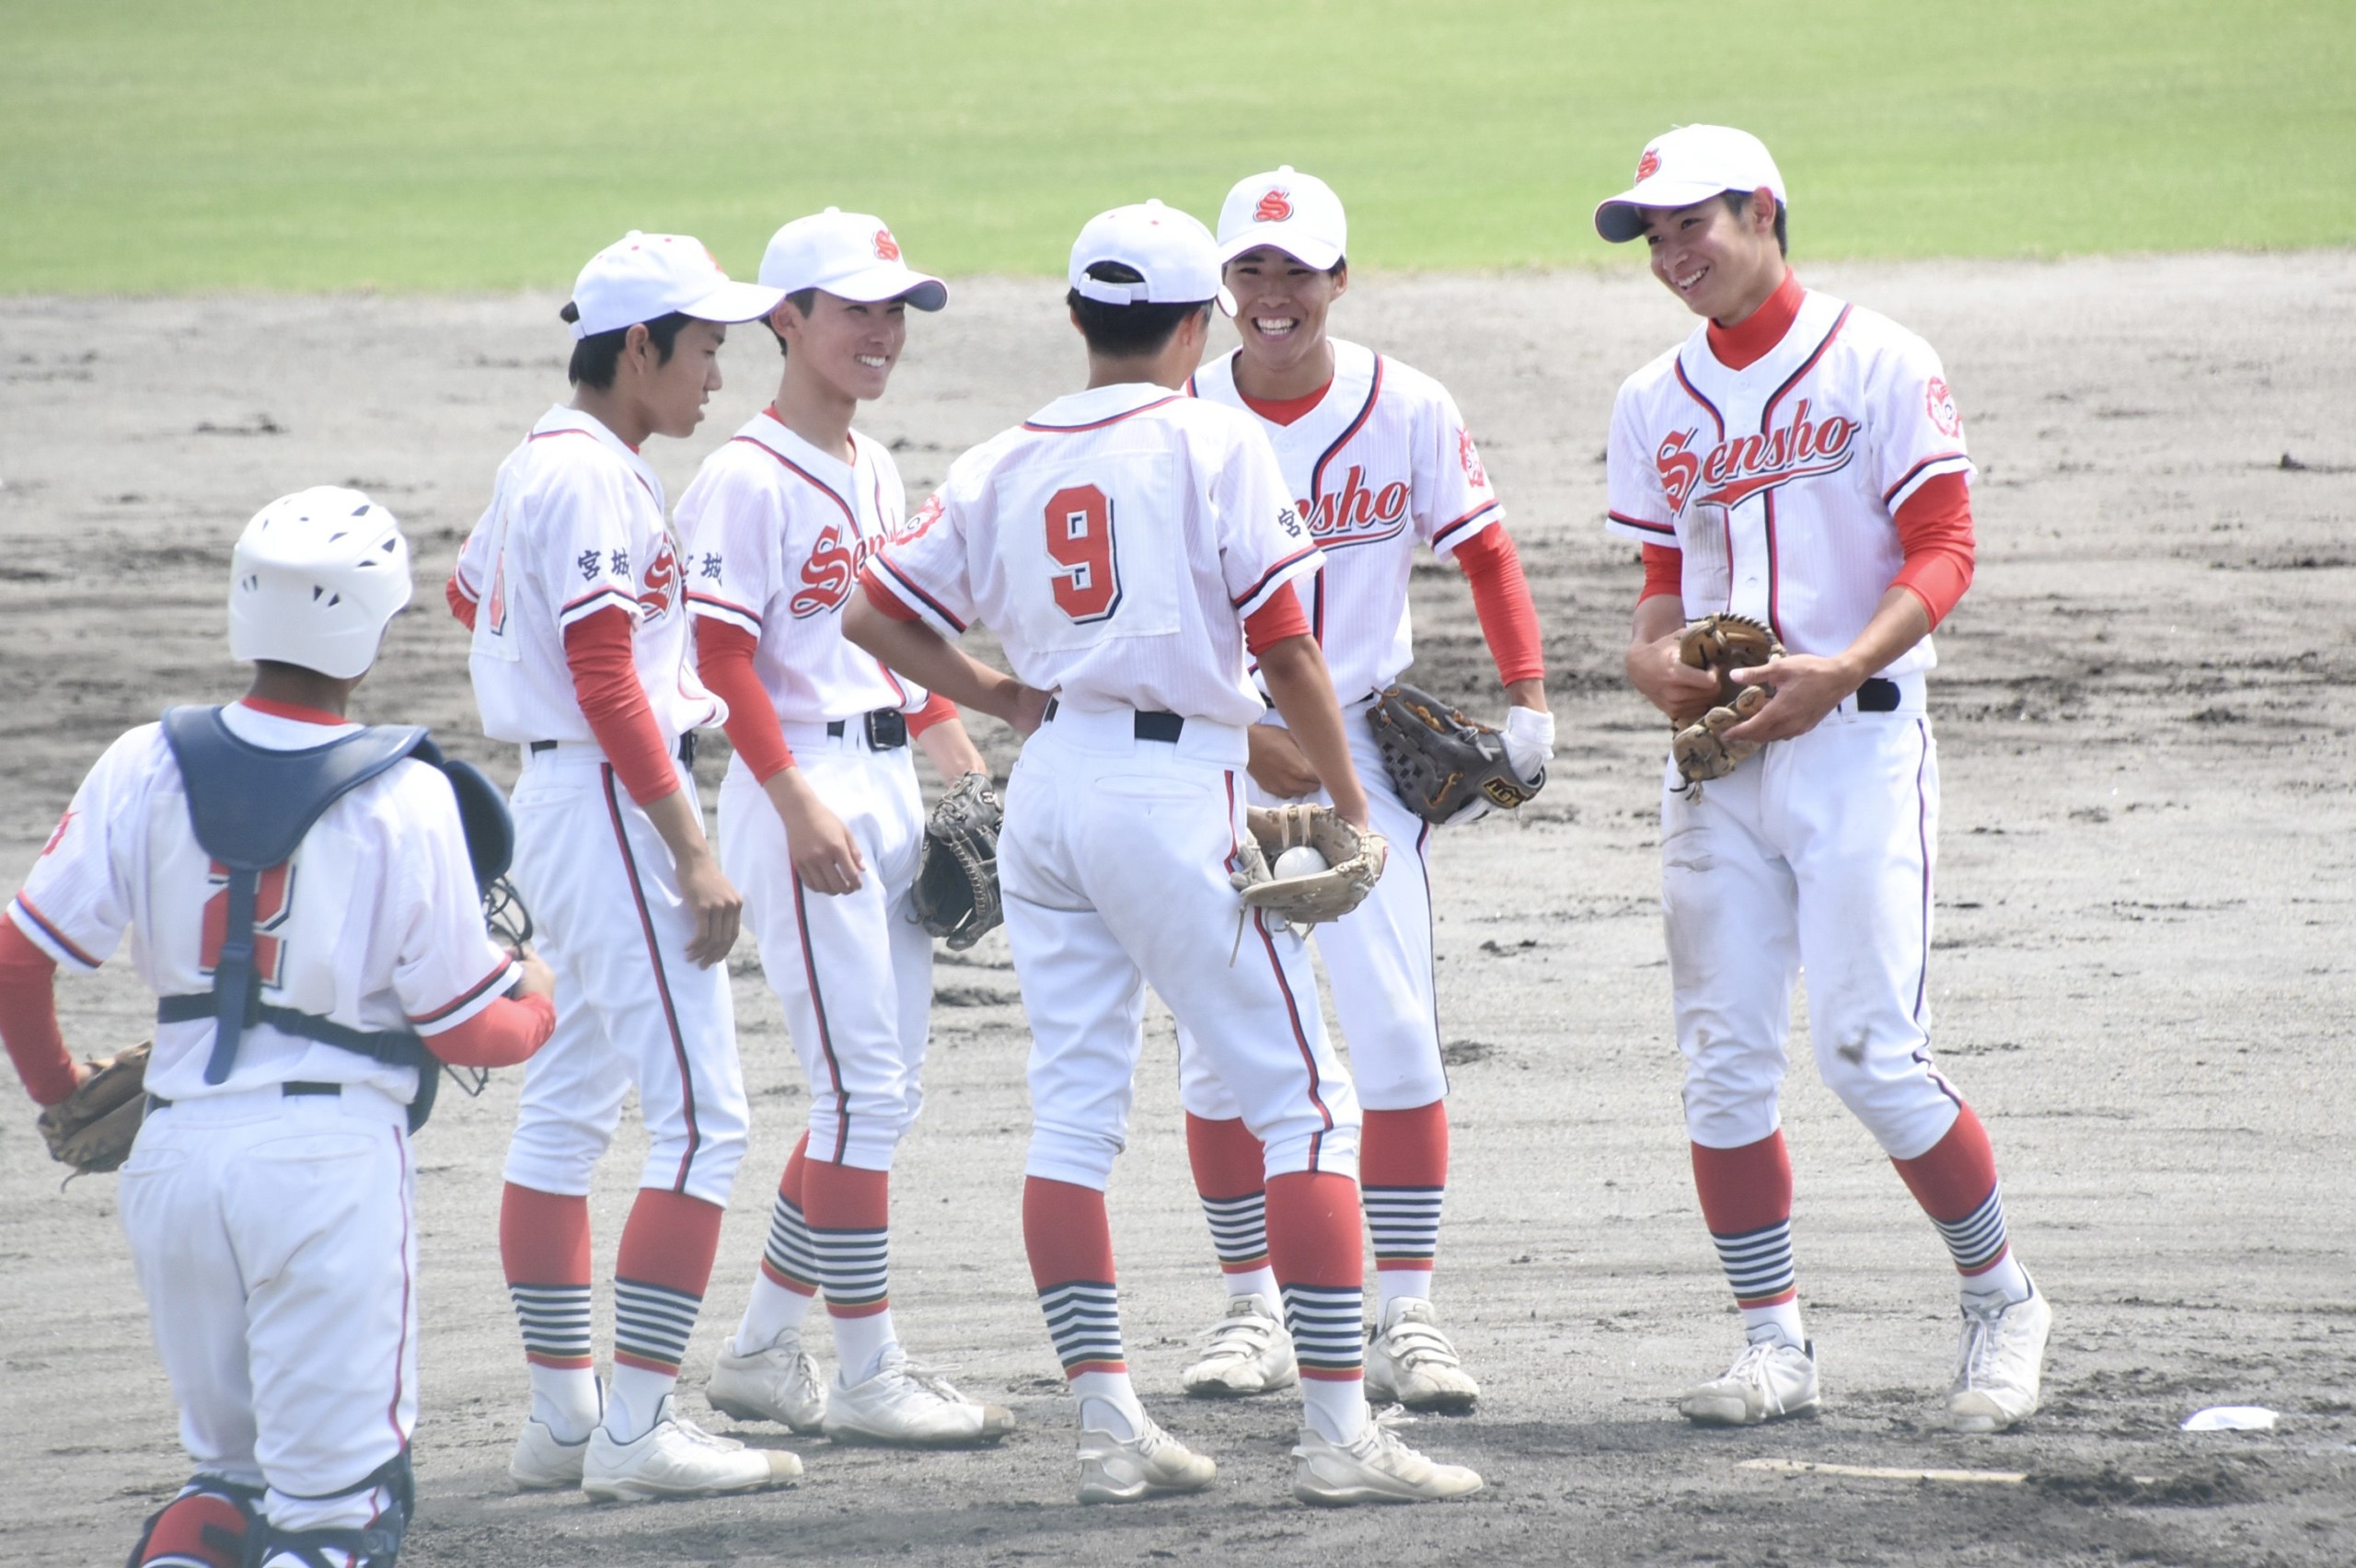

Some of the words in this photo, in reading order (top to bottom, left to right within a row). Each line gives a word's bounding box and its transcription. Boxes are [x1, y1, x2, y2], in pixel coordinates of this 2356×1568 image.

[1634, 148, 1662, 186] S
[1253, 190, 1294, 223] S
[872, 229, 900, 262] S
[1656, 398, 1861, 519] Sensho
[577, 547, 633, 582] 宮城
[1044, 483, 1123, 626] 9
